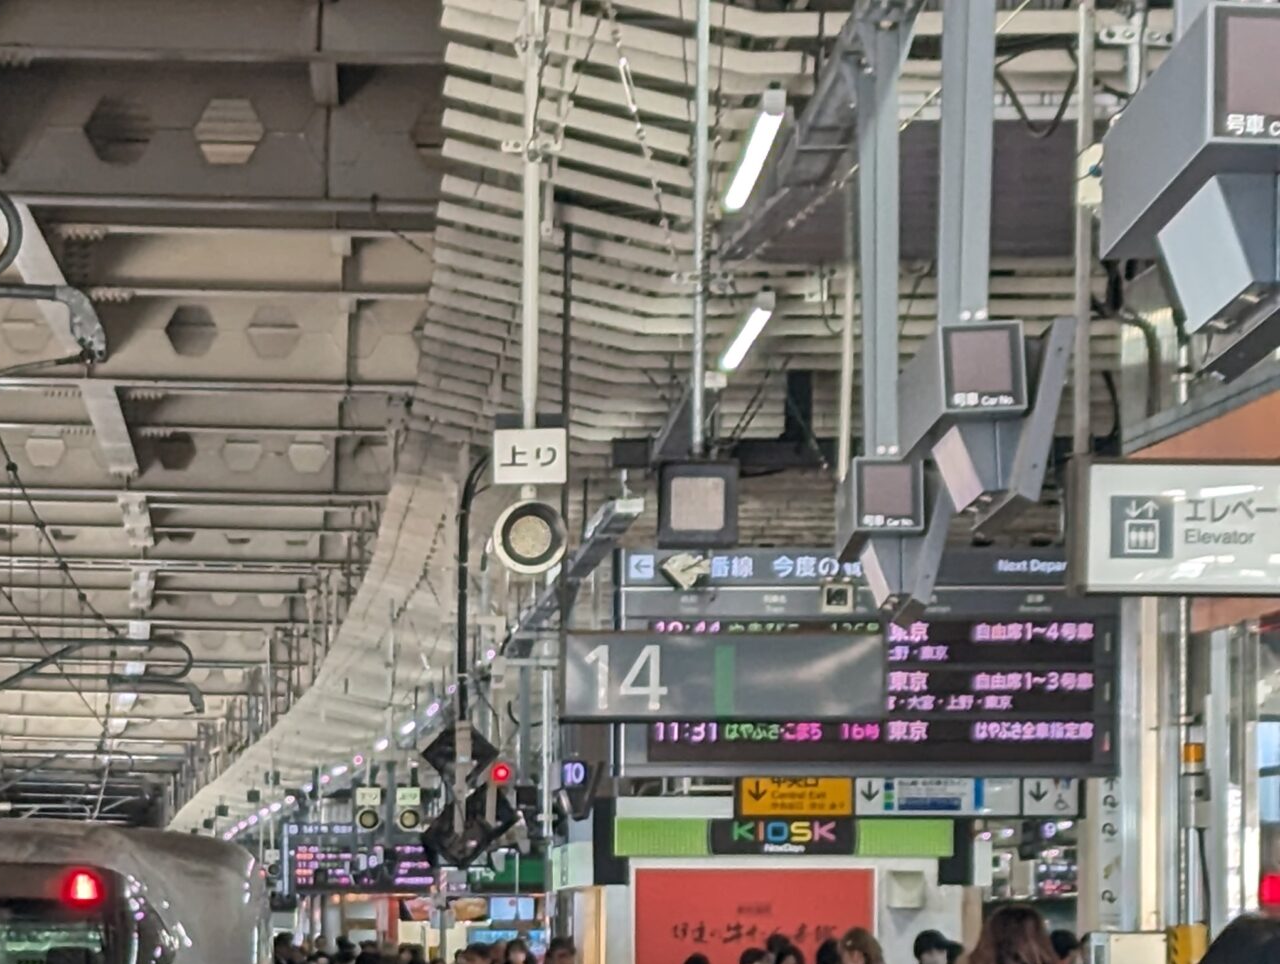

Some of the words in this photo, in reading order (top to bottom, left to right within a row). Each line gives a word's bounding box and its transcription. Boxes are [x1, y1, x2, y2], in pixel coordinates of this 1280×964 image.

[1227, 114, 1265, 135] 号車
[953, 392, 979, 406] 号車
[500, 445, 557, 467] 上り
[1185, 499, 1277, 523] エレベー
[1184, 528, 1256, 545] Elevator
[711, 555, 753, 578] 番線
[999, 559, 1028, 572] Next
[584, 644, 668, 710] 14
[888, 671, 929, 692] 東京
[888, 720, 929, 742] 東京
[564, 762, 585, 783] 10
[733, 820, 836, 842] KIOSK
